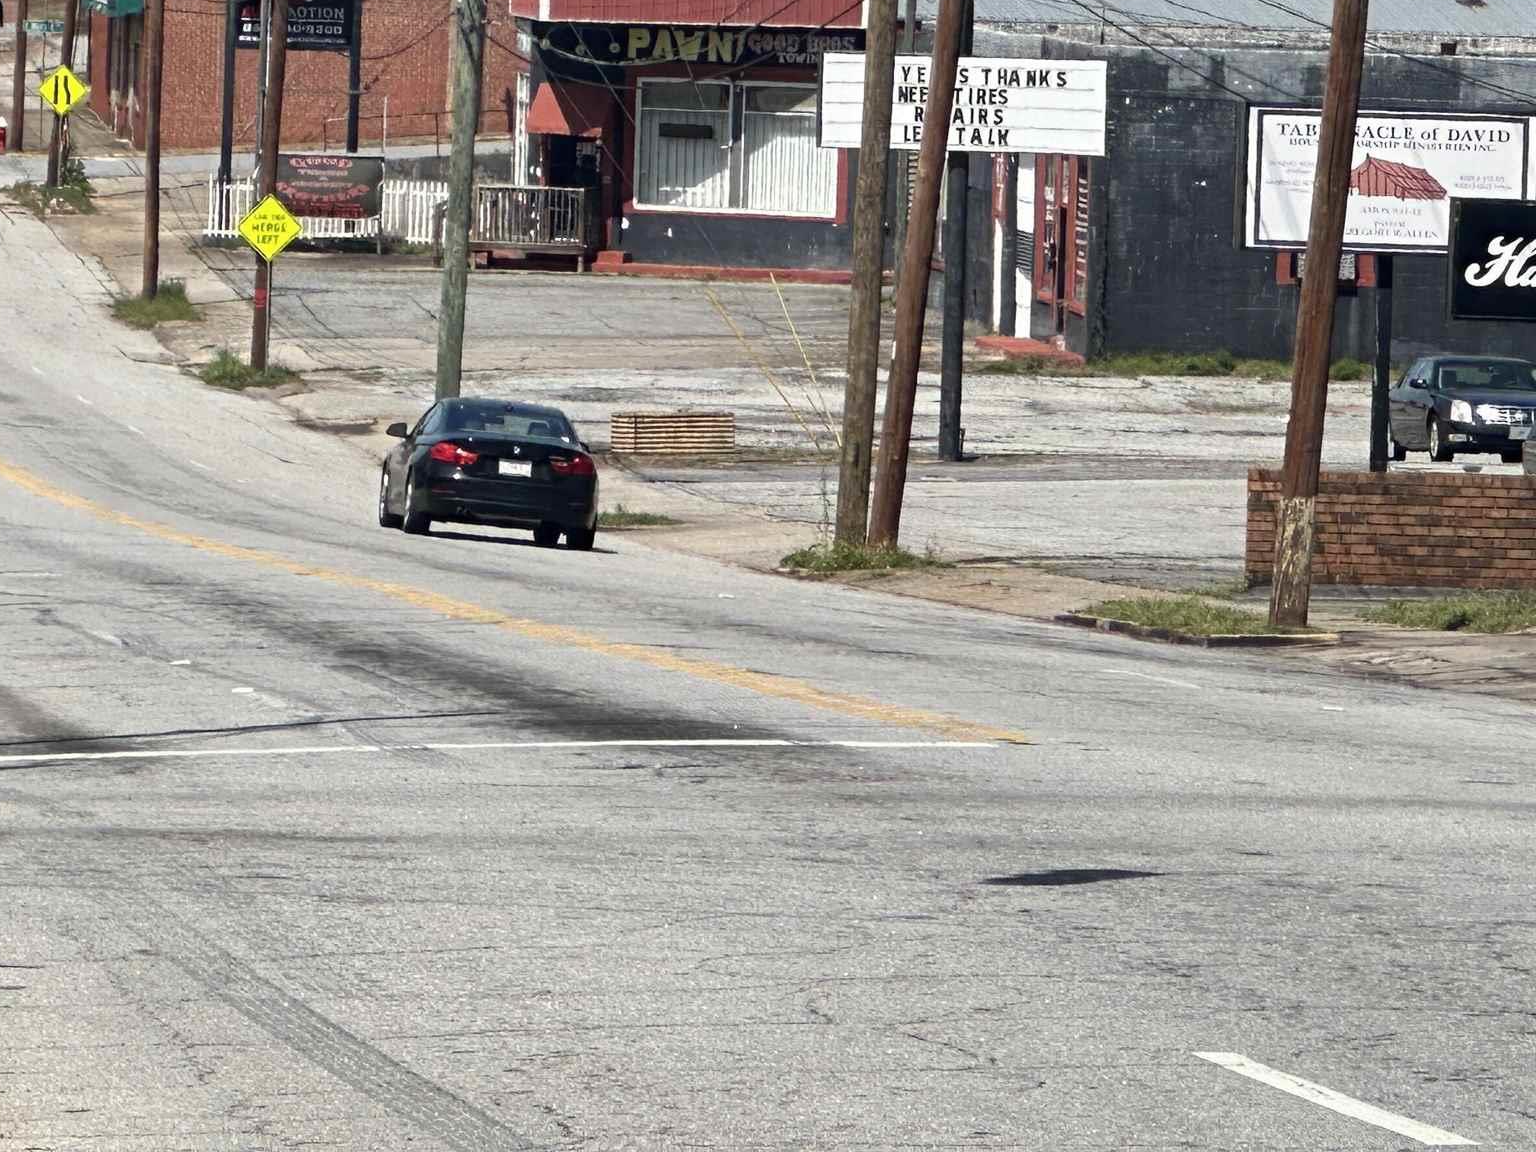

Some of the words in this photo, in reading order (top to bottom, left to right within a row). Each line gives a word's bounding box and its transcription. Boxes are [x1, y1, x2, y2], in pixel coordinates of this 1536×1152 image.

[626, 27, 735, 63] PAWN
[777, 51, 820, 64] TOWIN
[981, 68, 1068, 88] THANKS
[897, 85, 929, 104] NEE
[954, 86, 1009, 105] TIRES
[914, 106, 1004, 126] RAIRS
[955, 126, 1010, 146] TALK
[1420, 127, 1440, 141] of
[1447, 128, 1511, 143] DAVID
